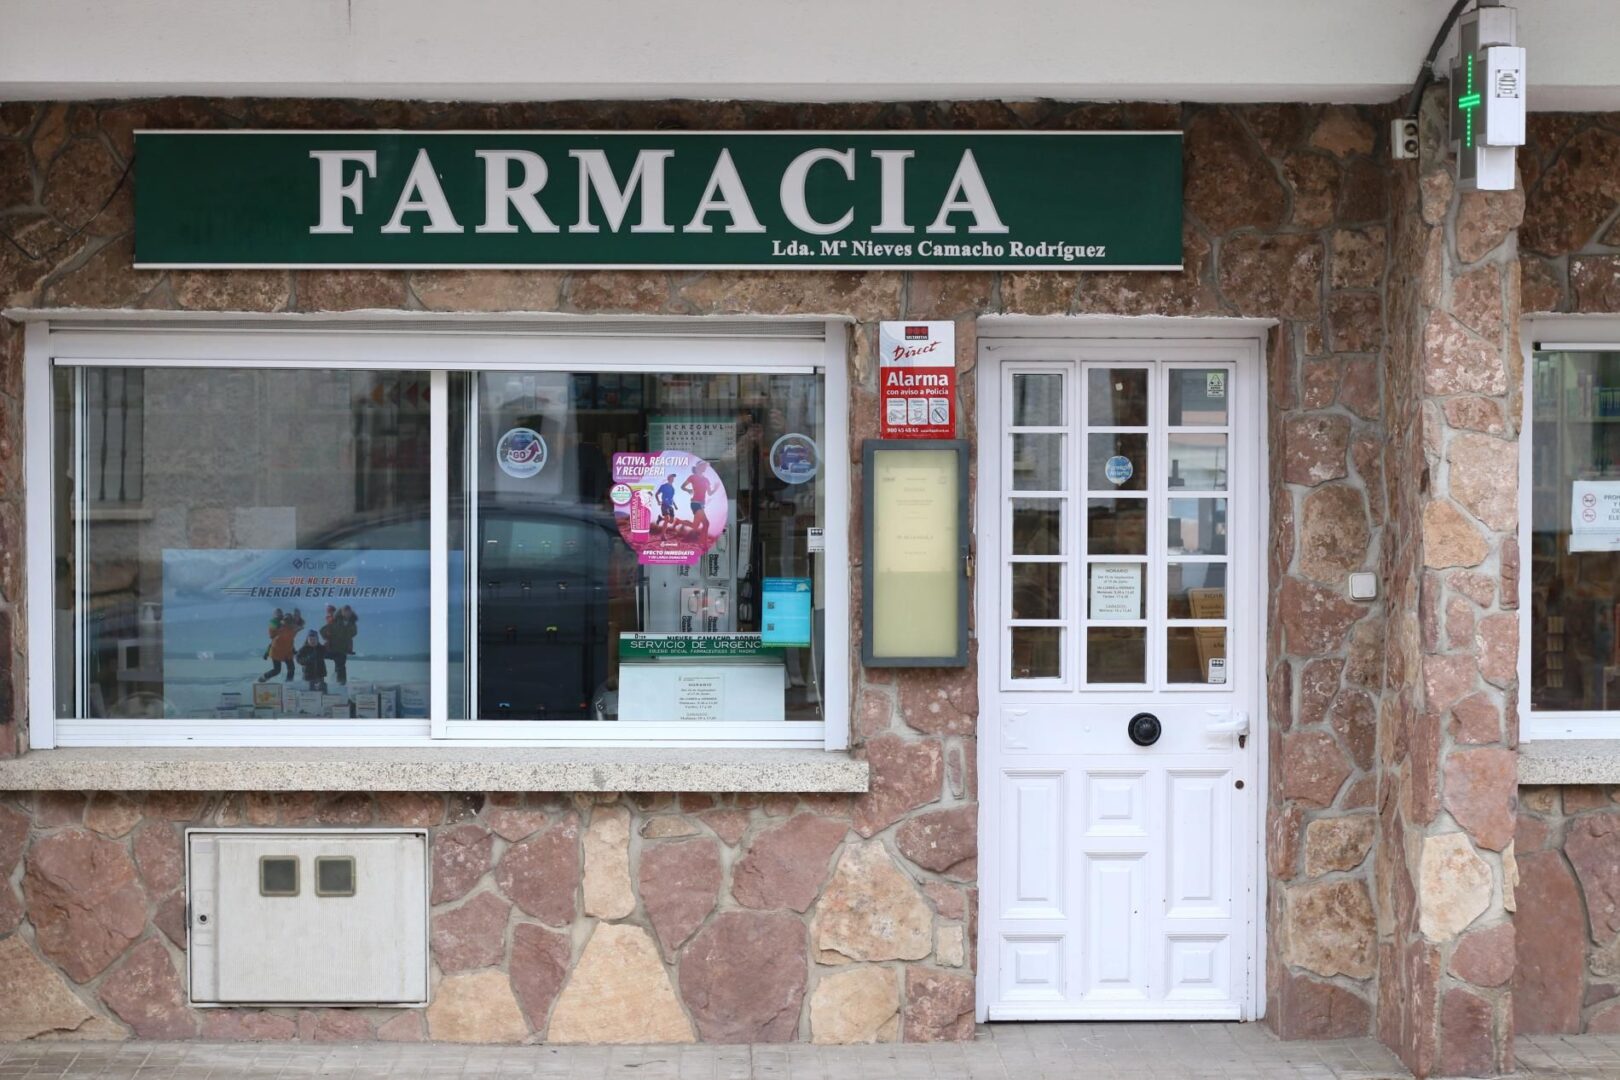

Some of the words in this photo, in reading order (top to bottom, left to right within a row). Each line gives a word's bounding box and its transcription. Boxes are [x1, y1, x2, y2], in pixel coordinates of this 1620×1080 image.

[308, 147, 1010, 235] FARMACIA
[771, 240, 815, 256] Lda.
[820, 240, 847, 256] Mª
[852, 240, 912, 256] Nieves
[917, 240, 1004, 256] Camacho
[1009, 239, 1106, 261] Rodríguez
[893, 341, 941, 361] Direct
[887, 371, 949, 386] Alarma
[900, 387, 919, 395] aviso
[615, 456, 647, 467] ACTIVA,
[648, 456, 689, 466] REACTIVA
[615, 466, 622, 475] Y
[622, 466, 665, 476] RECUPERA
[303, 557, 337, 571] farline
[289, 576, 304, 585] QUE
[307, 576, 318, 585] NO
[321, 576, 331, 585] TE
[333, 576, 356, 585] FALTE
[251, 585, 301, 598] ENERGÍA
[305, 587, 334, 598] ESTE
[338, 587, 396, 598] INVIERNO
[630, 640, 685, 649] SERVICIO
[691, 640, 707, 649] DE
[713, 640, 770, 649] URGENC
